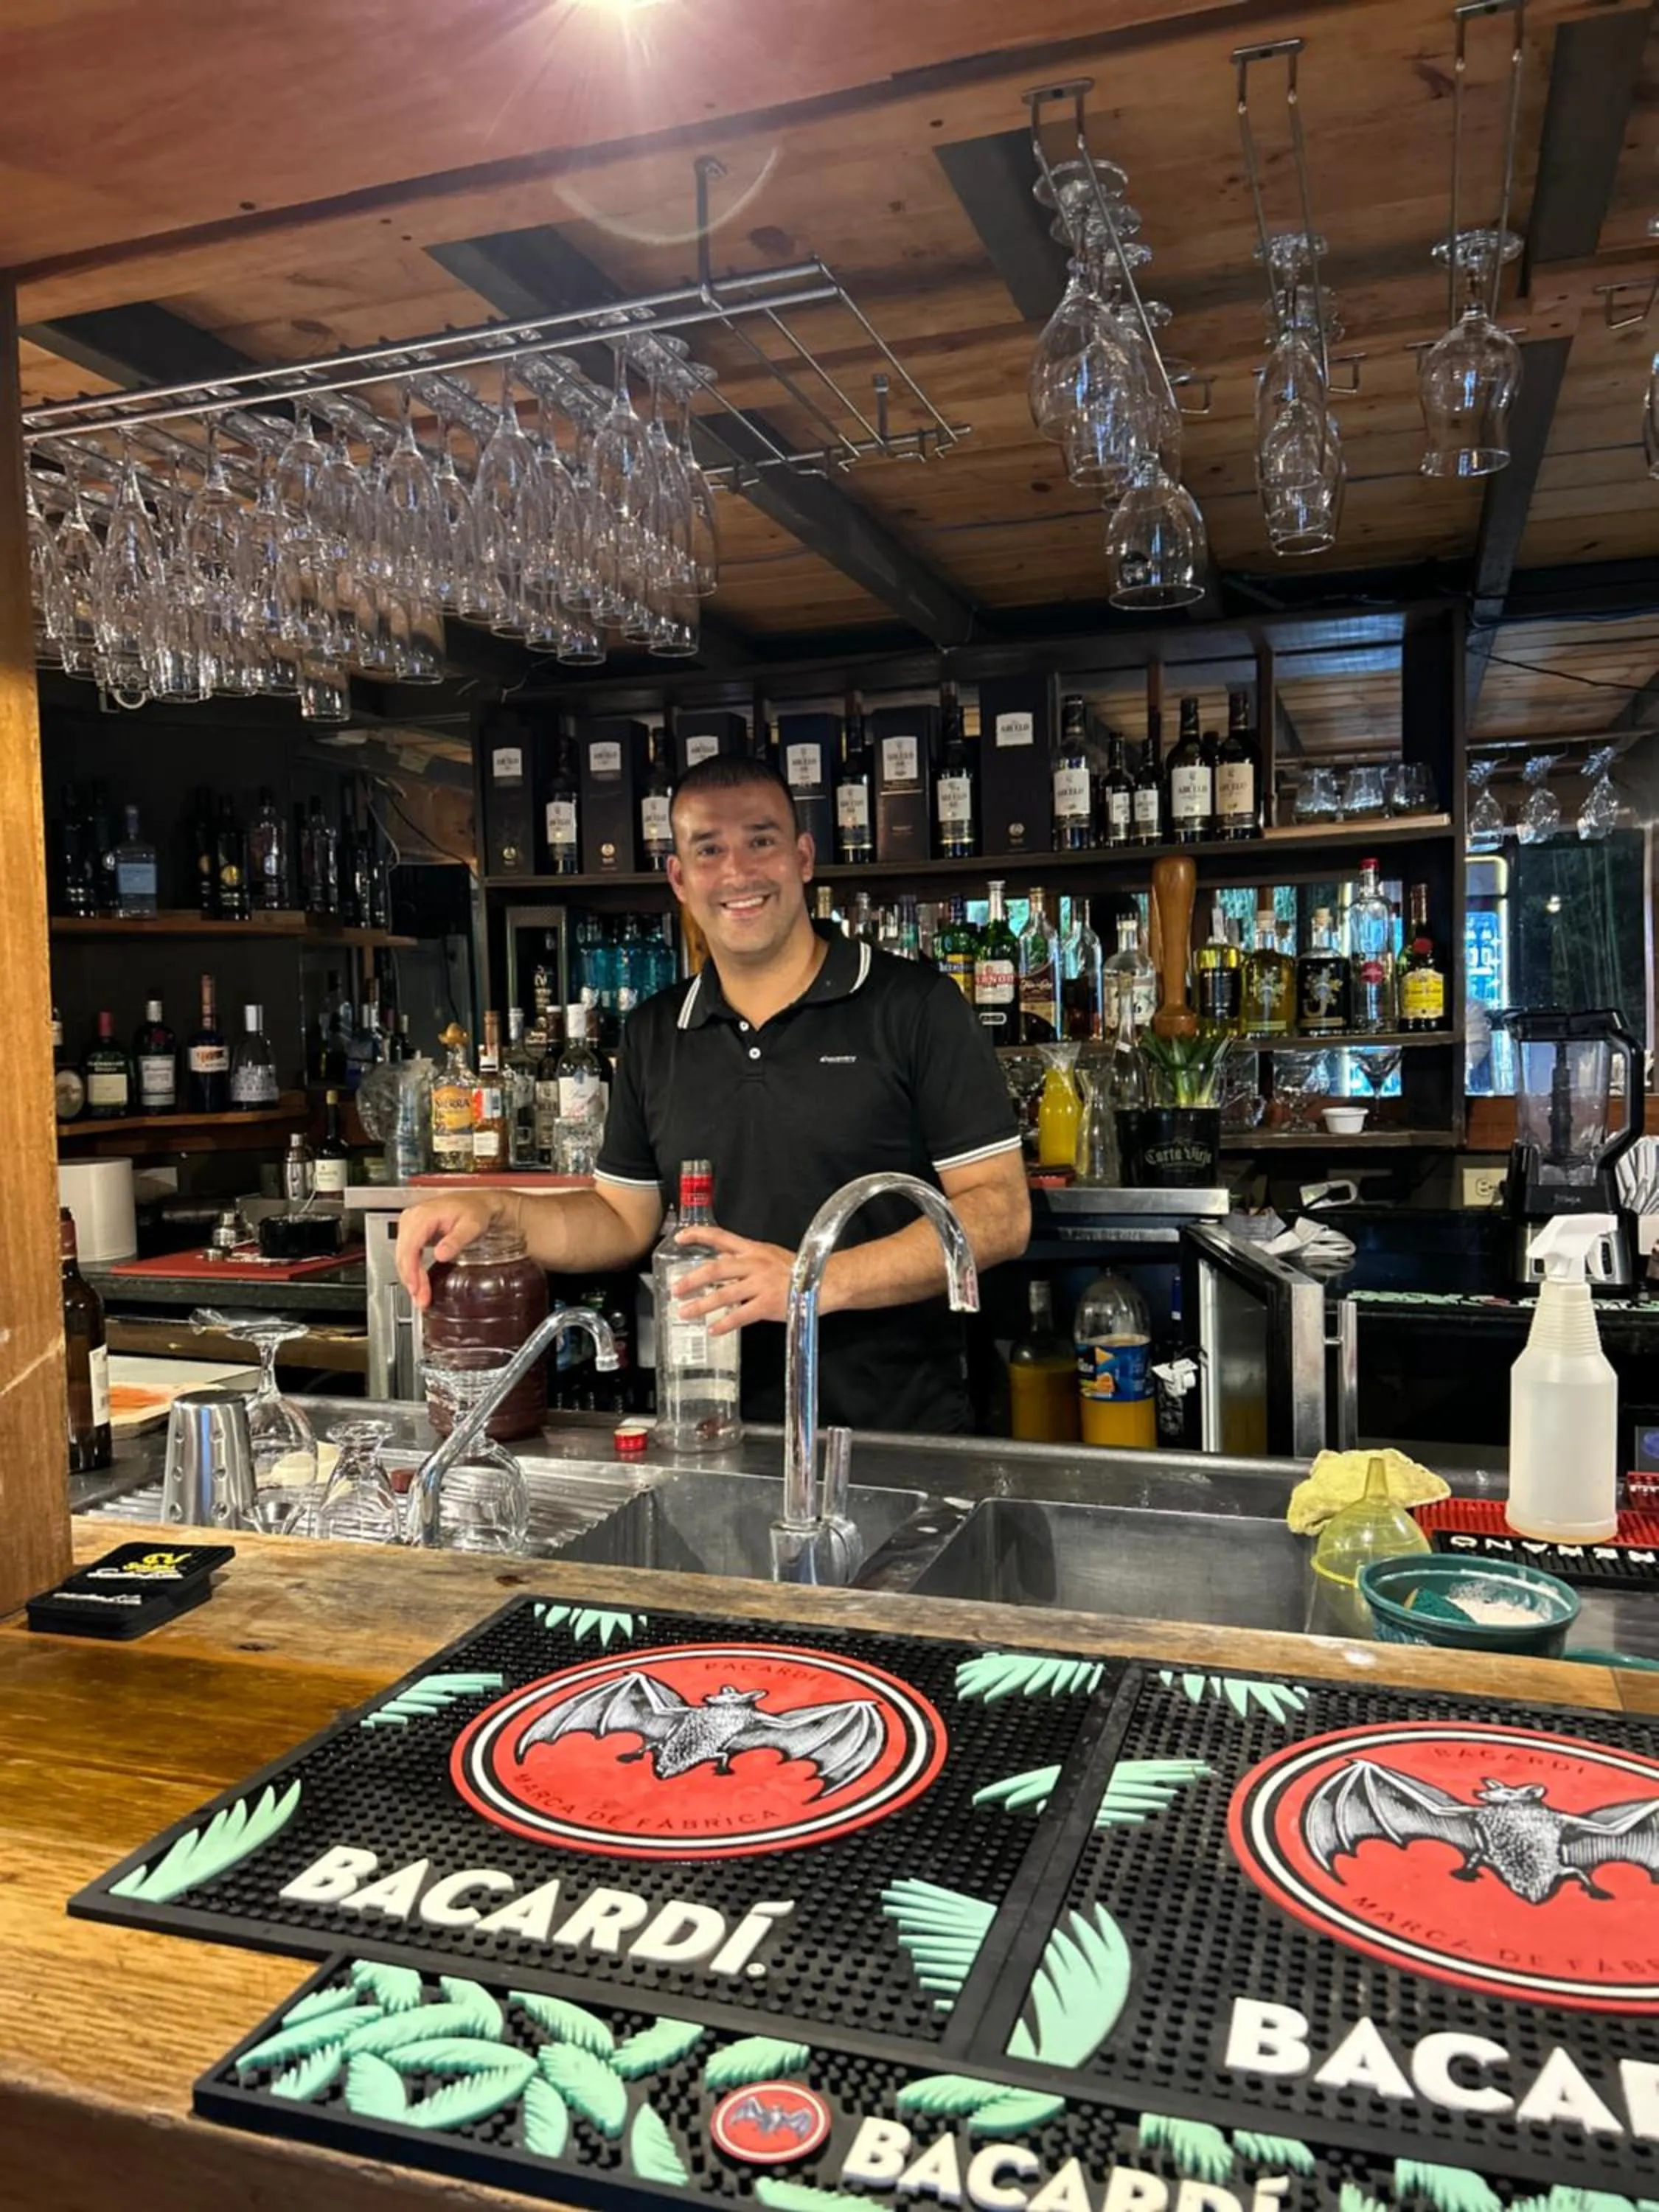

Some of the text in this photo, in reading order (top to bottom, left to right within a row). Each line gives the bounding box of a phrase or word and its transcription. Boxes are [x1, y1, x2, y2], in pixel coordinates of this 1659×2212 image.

[515, 1773, 576, 1815] MARCA
[585, 1809, 623, 1829] DE
[1225, 1997, 1659, 2138] BACA
